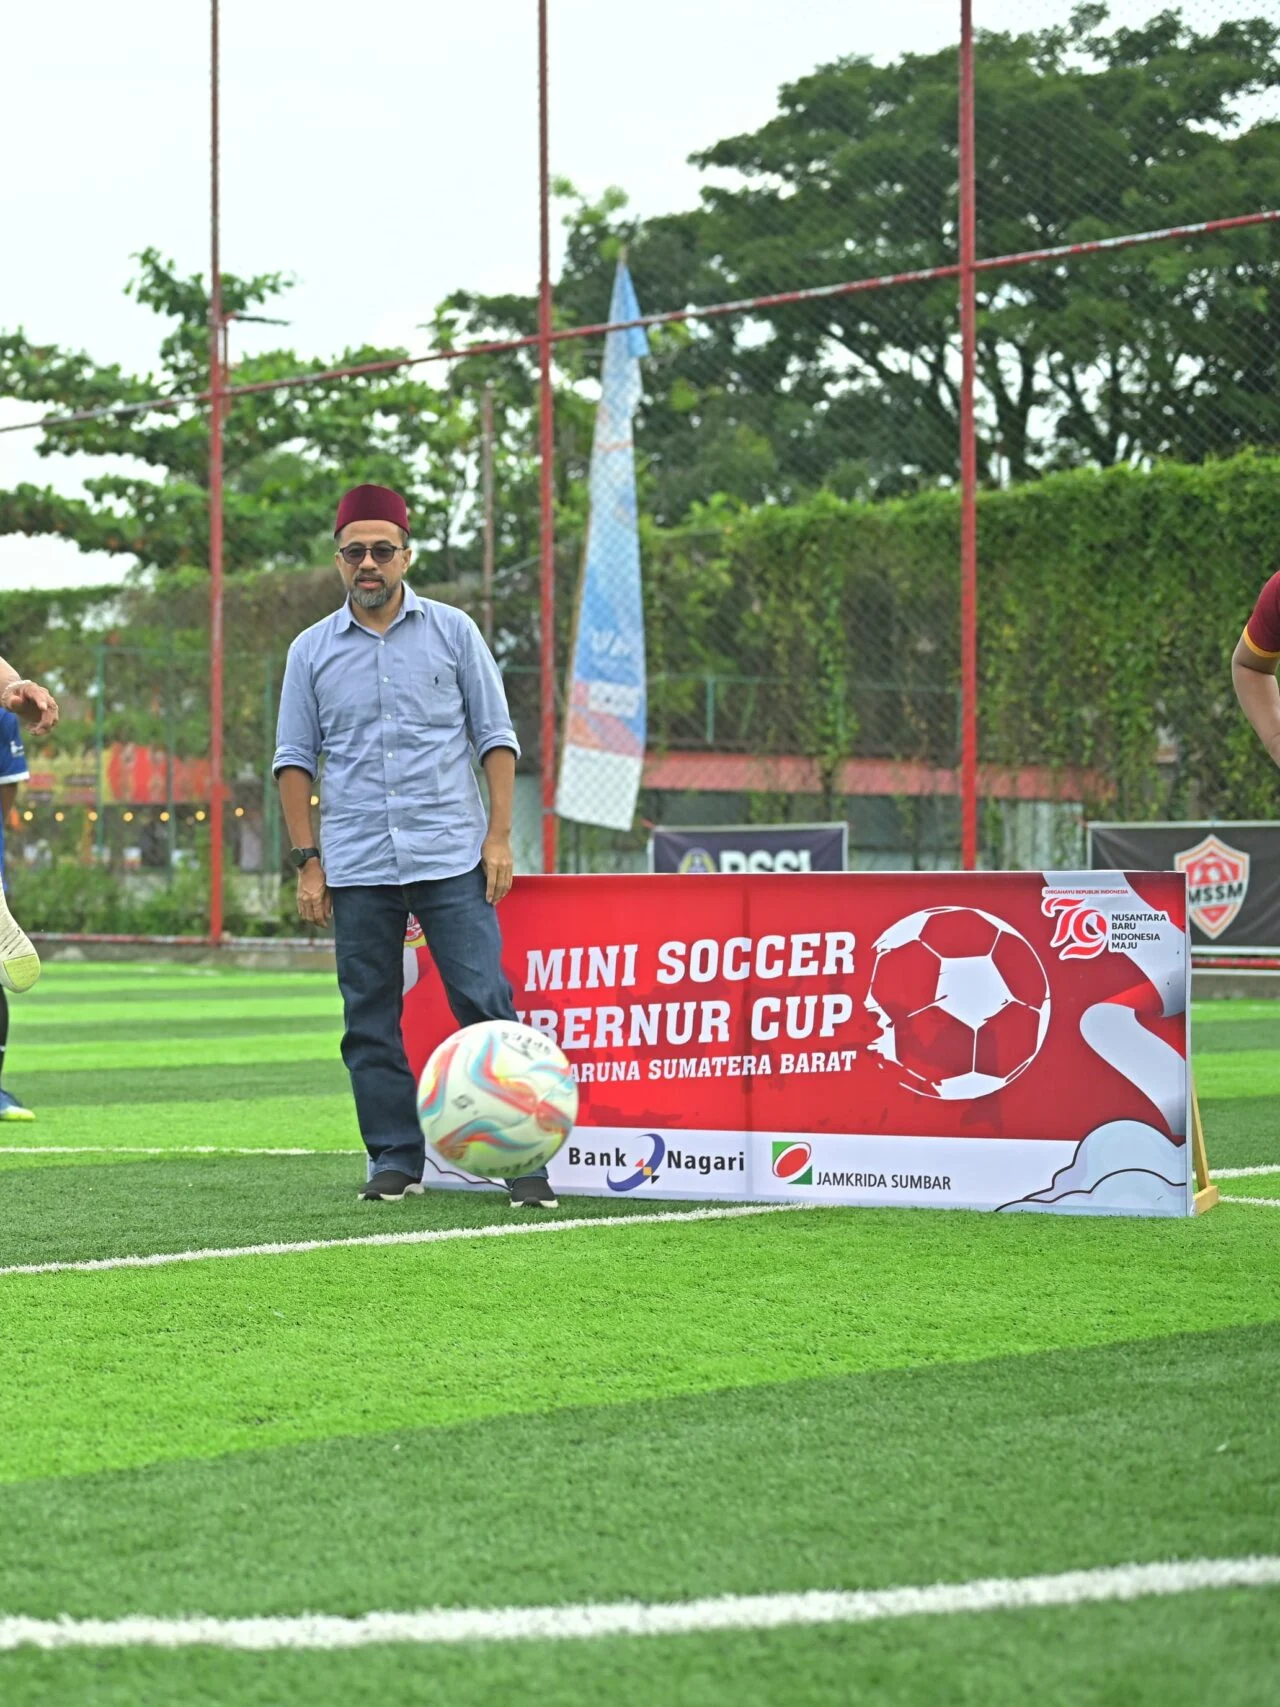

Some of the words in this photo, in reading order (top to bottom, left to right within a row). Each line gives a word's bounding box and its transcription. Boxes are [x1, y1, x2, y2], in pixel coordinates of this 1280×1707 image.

[1188, 882, 1243, 904] MSSM
[1043, 897, 1108, 959] 79
[1111, 913, 1167, 922] NUSANTARA
[1111, 922, 1137, 930] BARU
[1111, 932, 1161, 941] INDONESIA
[1111, 942, 1138, 950] MAJU
[524, 943, 638, 992] MINI
[656, 931, 856, 985] SOCCER
[516, 999, 731, 1050] BERNUR
[750, 993, 853, 1041] CUP
[648, 1054, 772, 1080] SUMATERA
[780, 1050, 857, 1074] BARAT
[568, 1147, 627, 1167] Bank
[667, 1149, 745, 1175] Nagari
[816, 1171, 888, 1188] JAMKRIDA
[891, 1174, 951, 1191] SUMBAR
